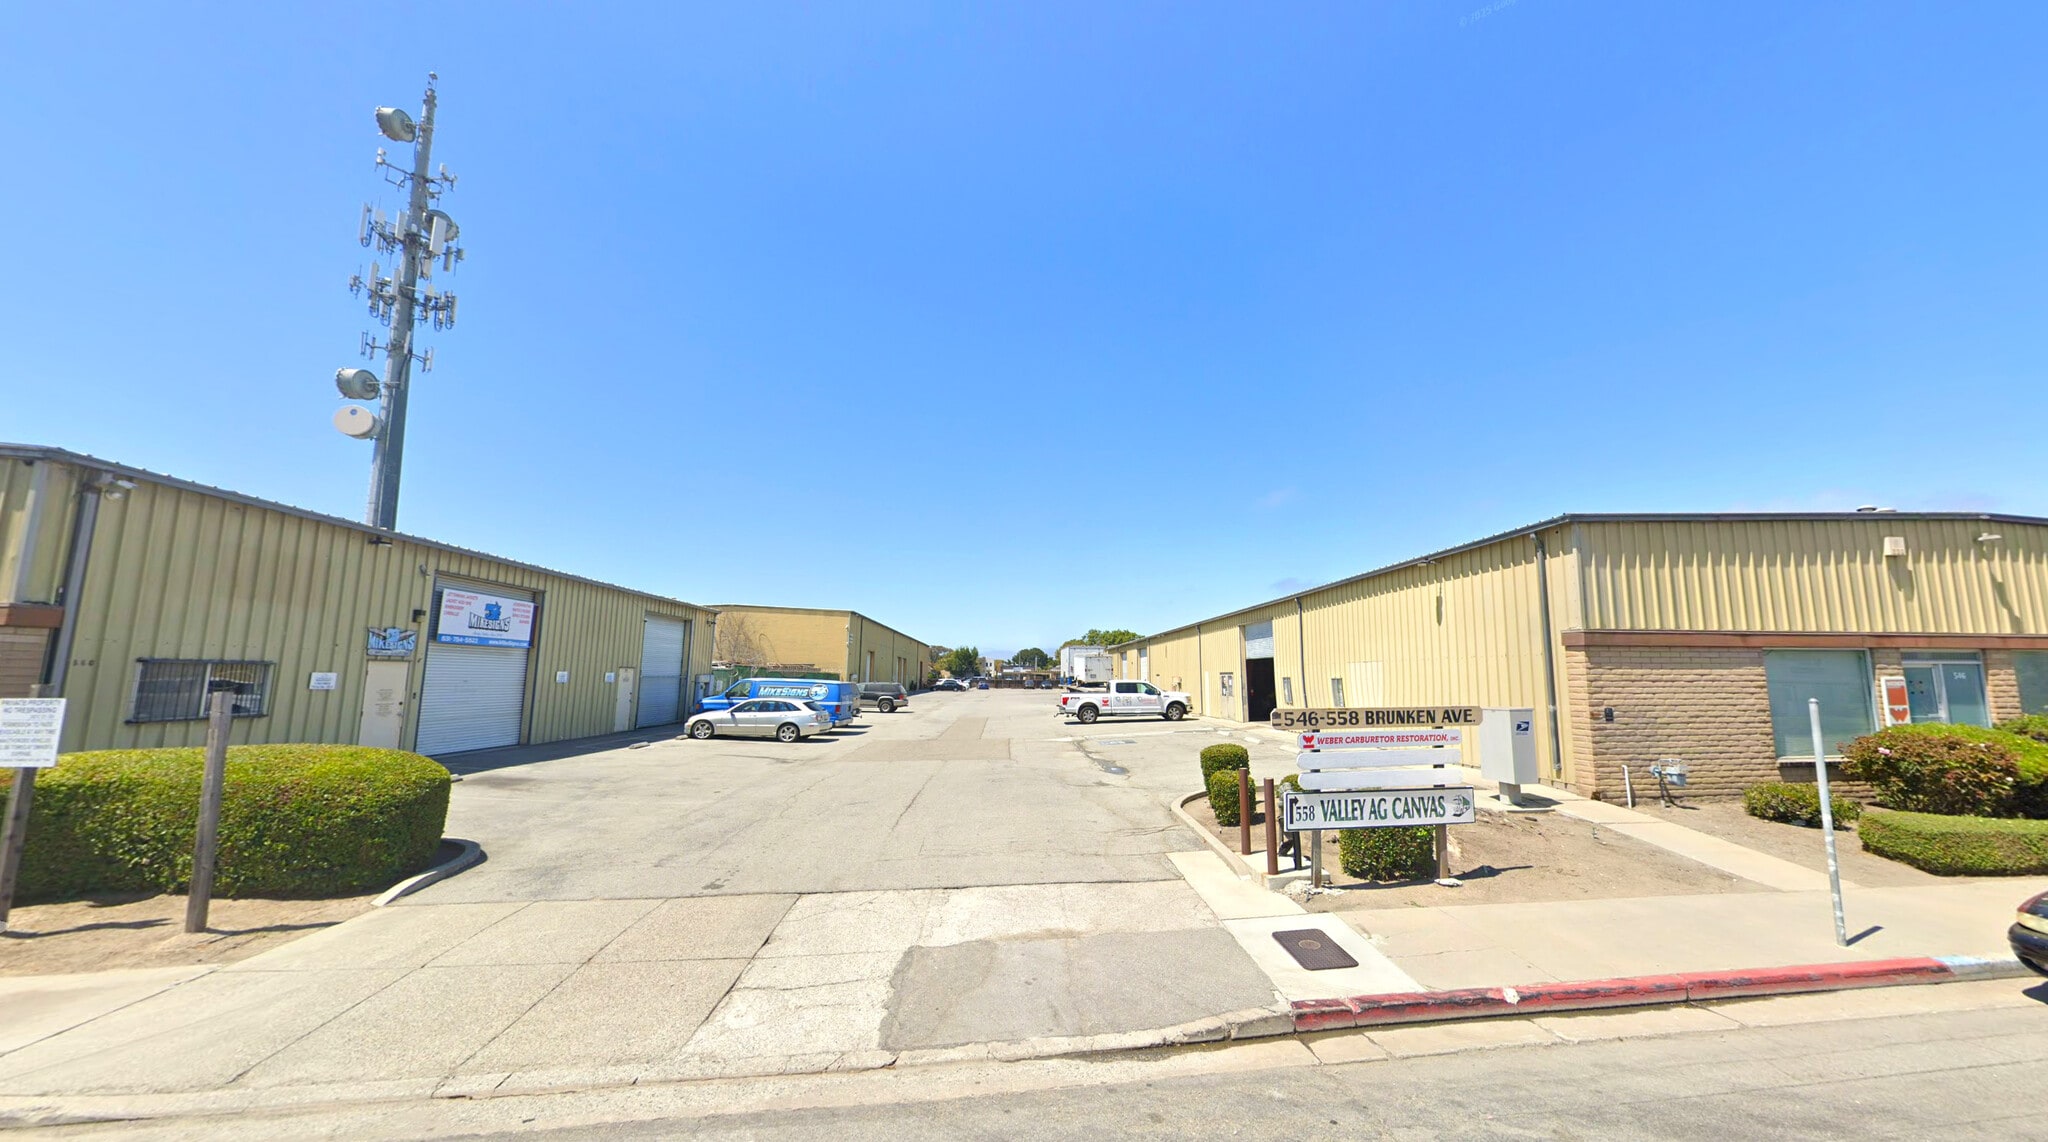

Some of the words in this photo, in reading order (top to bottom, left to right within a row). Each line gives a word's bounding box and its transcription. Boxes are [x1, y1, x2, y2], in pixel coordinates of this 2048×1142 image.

[1284, 711, 1359, 727] 546-558
[1365, 709, 1436, 725] BRUNKEN
[1441, 708, 1476, 723] AVE.
[1317, 736, 1343, 745] WEBER
[1345, 735, 1395, 744] CARBURETOR
[1396, 734, 1449, 743] RESTORATION,
[1295, 805, 1316, 822] 558
[1320, 798, 1366, 822] VALLEY
[1368, 798, 1388, 821] AG
[1391, 795, 1446, 820] CANVAS
